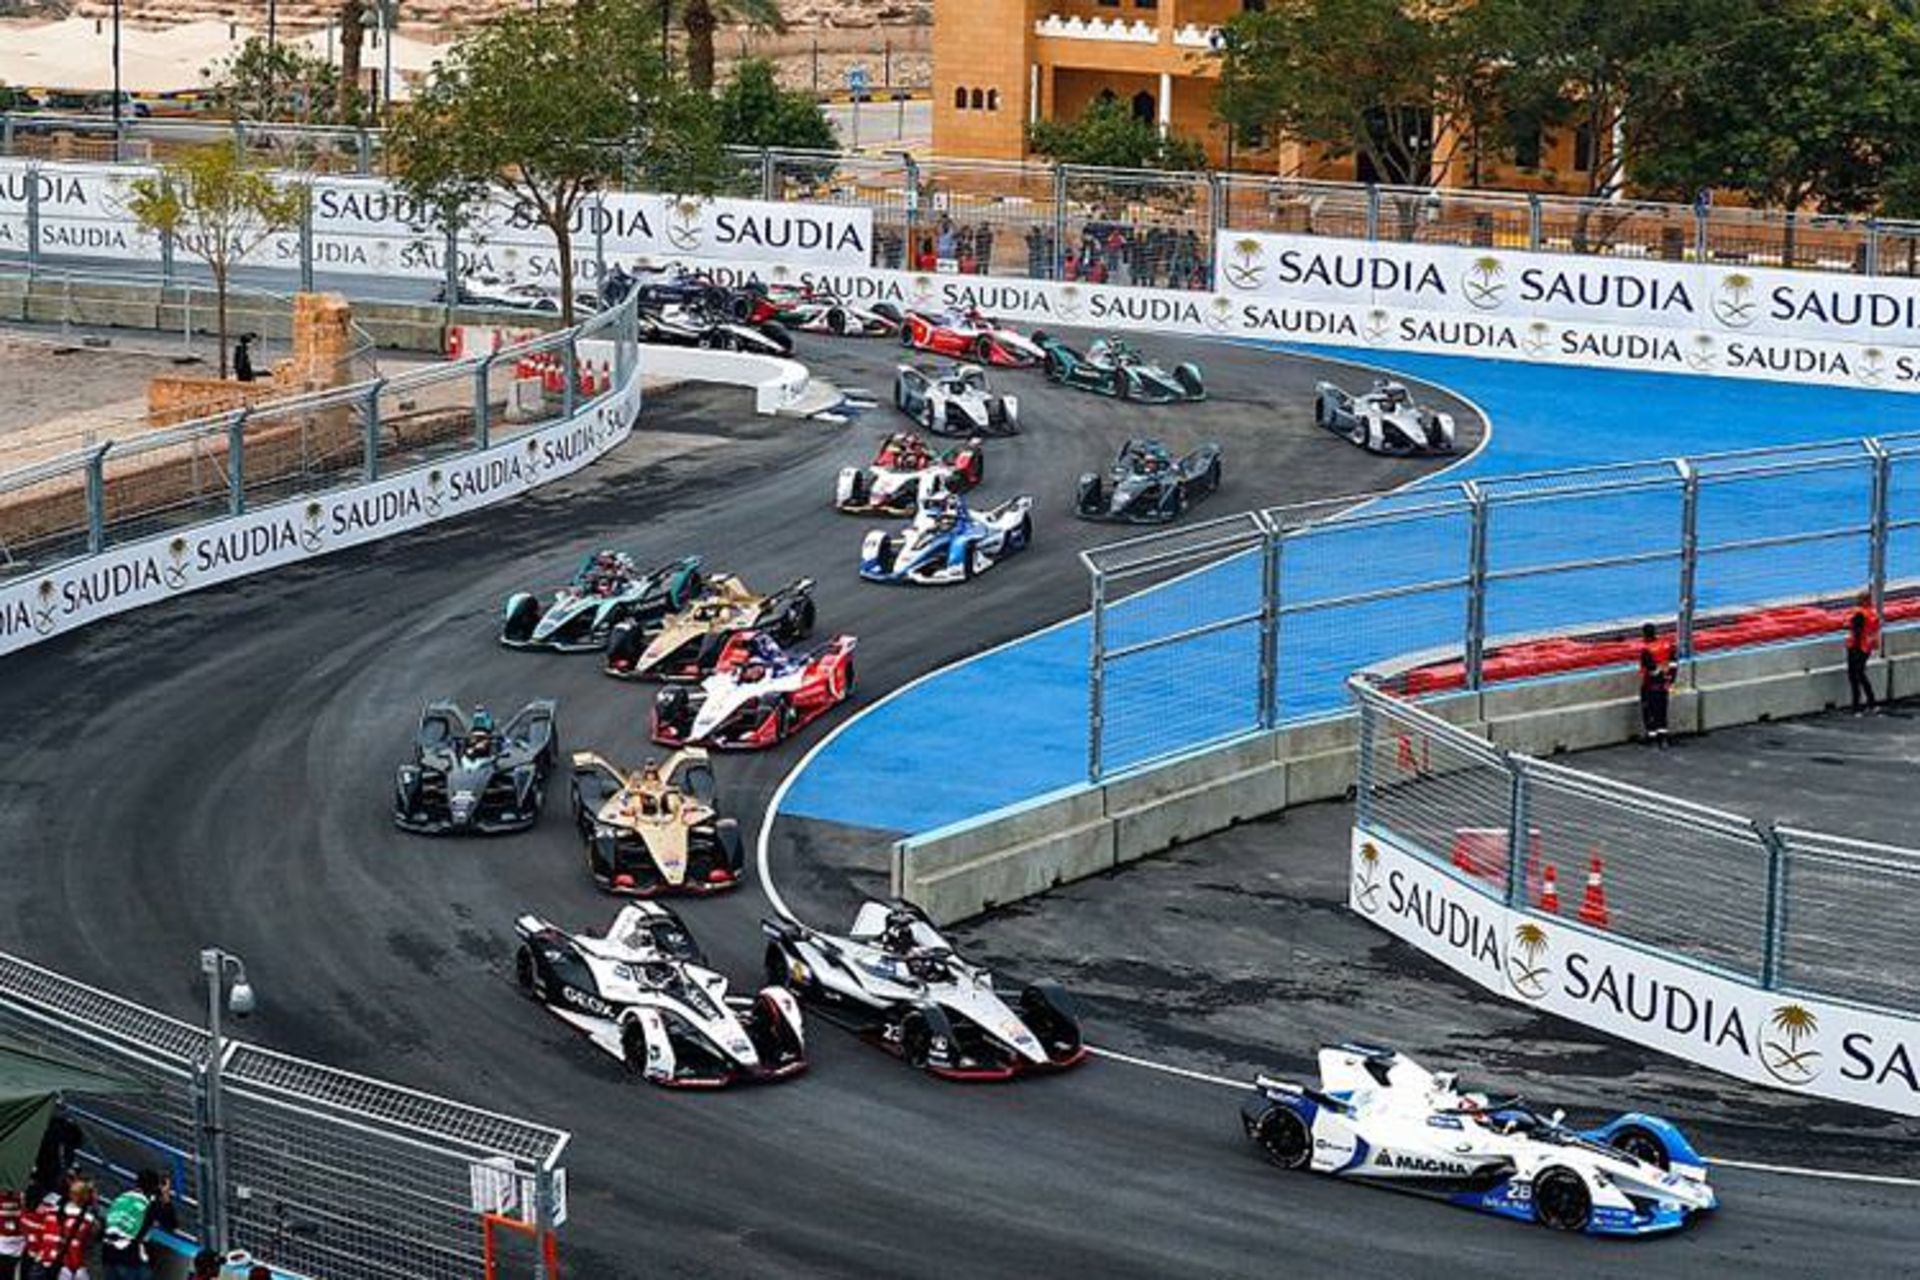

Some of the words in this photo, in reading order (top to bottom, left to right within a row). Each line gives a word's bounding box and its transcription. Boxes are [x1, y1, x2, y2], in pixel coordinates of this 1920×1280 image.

[715, 213, 864, 251] SAUDIA
[43, 225, 127, 249] SAUDIA
[799, 272, 904, 301] SAUDIA
[942, 283, 1051, 313] SAUDIA
[1090, 294, 1200, 325] SAUDIA
[1243, 305, 1358, 337] SAUDIA
[1400, 317, 1517, 350] SAUDIA
[1561, 330, 1682, 363] SAUDIA
[1727, 343, 1850, 376] SAUDIA
[1279, 250, 1447, 295] SAUDIA
[1520, 269, 1694, 313] SAUDIA
[1771, 286, 1920, 330] SAUDI
[62, 556, 161, 615] SAUDIA
[197, 519, 298, 572] SAUDIA
[332, 488, 421, 536] SAUDIA
[450, 456, 523, 500] SAUDIA
[543, 424, 595, 469] SAUDIA
[1388, 871, 1501, 971] SAUDIA
[1564, 952, 1751, 1057] SAUDIA
[1395, 1155, 1468, 1175] MAGNA
[1507, 1182, 1532, 1200] 28
